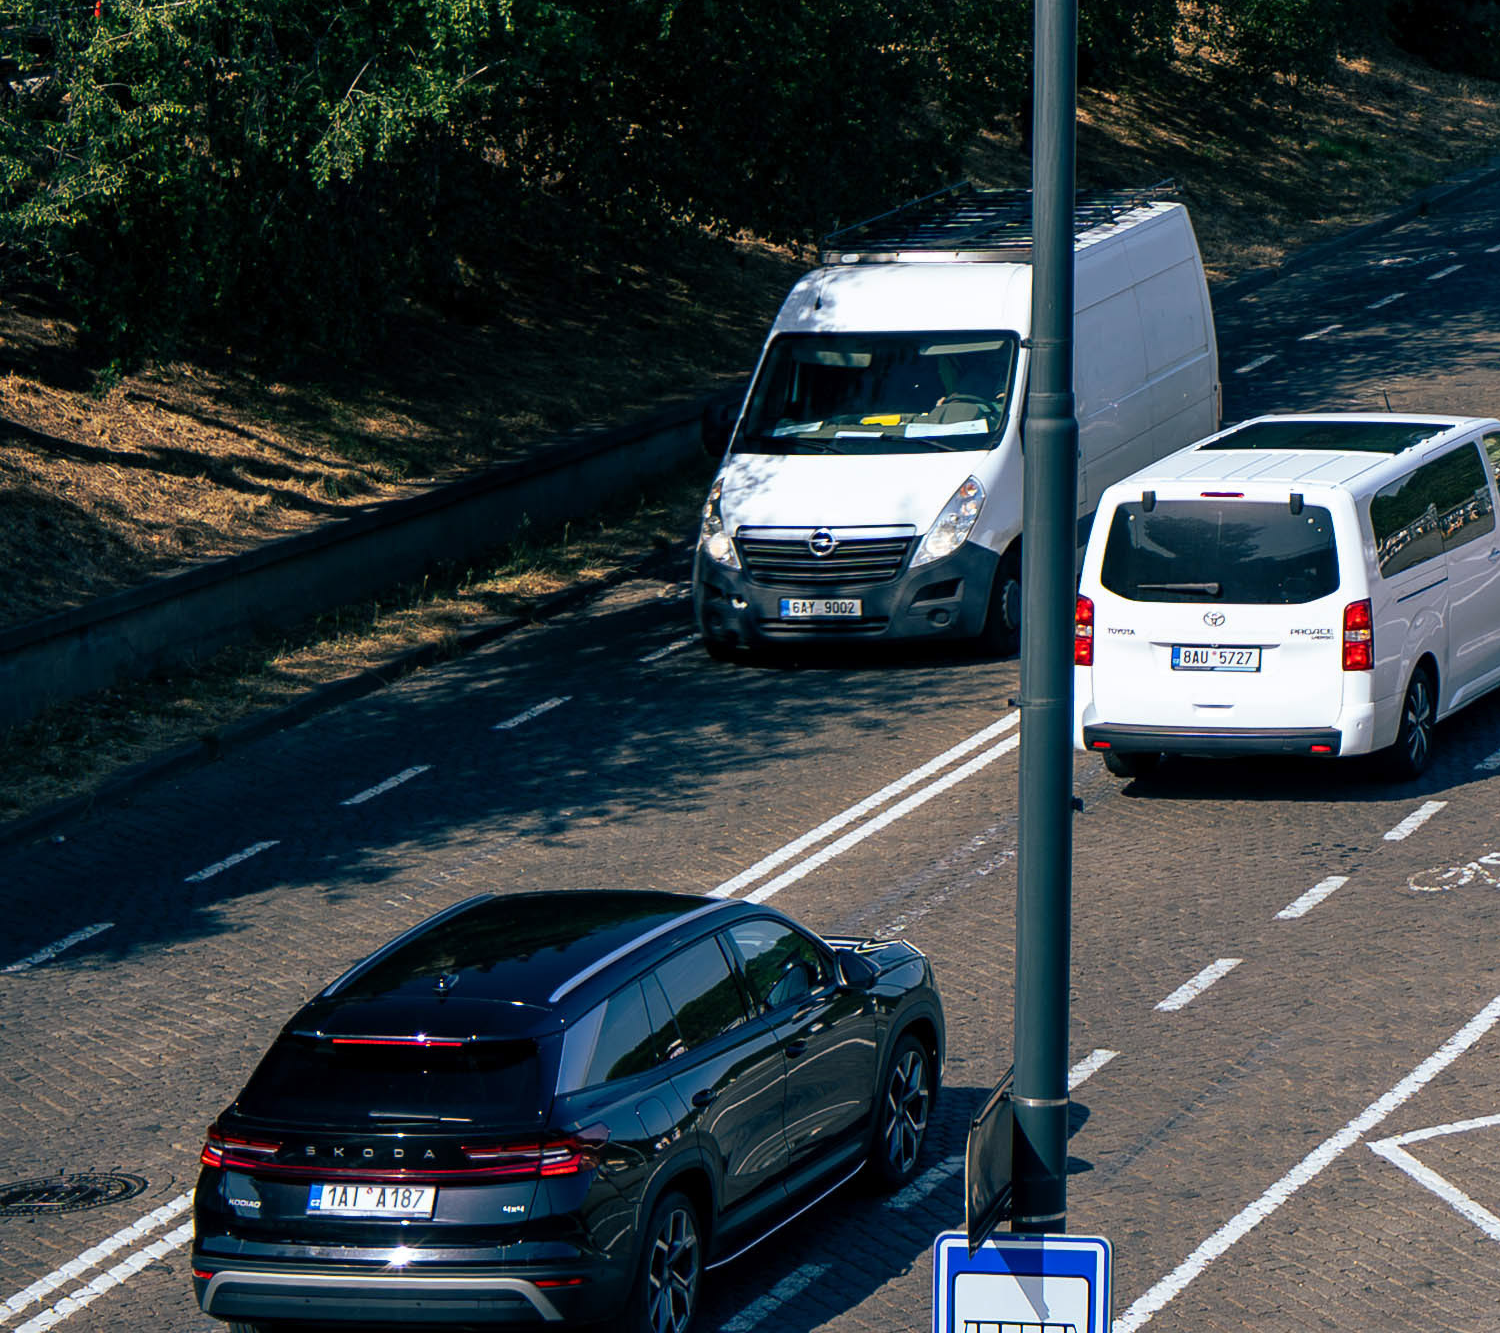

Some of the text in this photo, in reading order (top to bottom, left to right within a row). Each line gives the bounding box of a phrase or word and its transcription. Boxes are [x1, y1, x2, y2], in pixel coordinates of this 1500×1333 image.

[792, 601, 856, 614] 6AY 9002
[1107, 627, 1334, 636] TOYOTA PROACE
[1183, 650, 1253, 666] 8AU 5727
[228, 1197, 262, 1209] KODIAQ
[376, 1188, 426, 1210] A187
